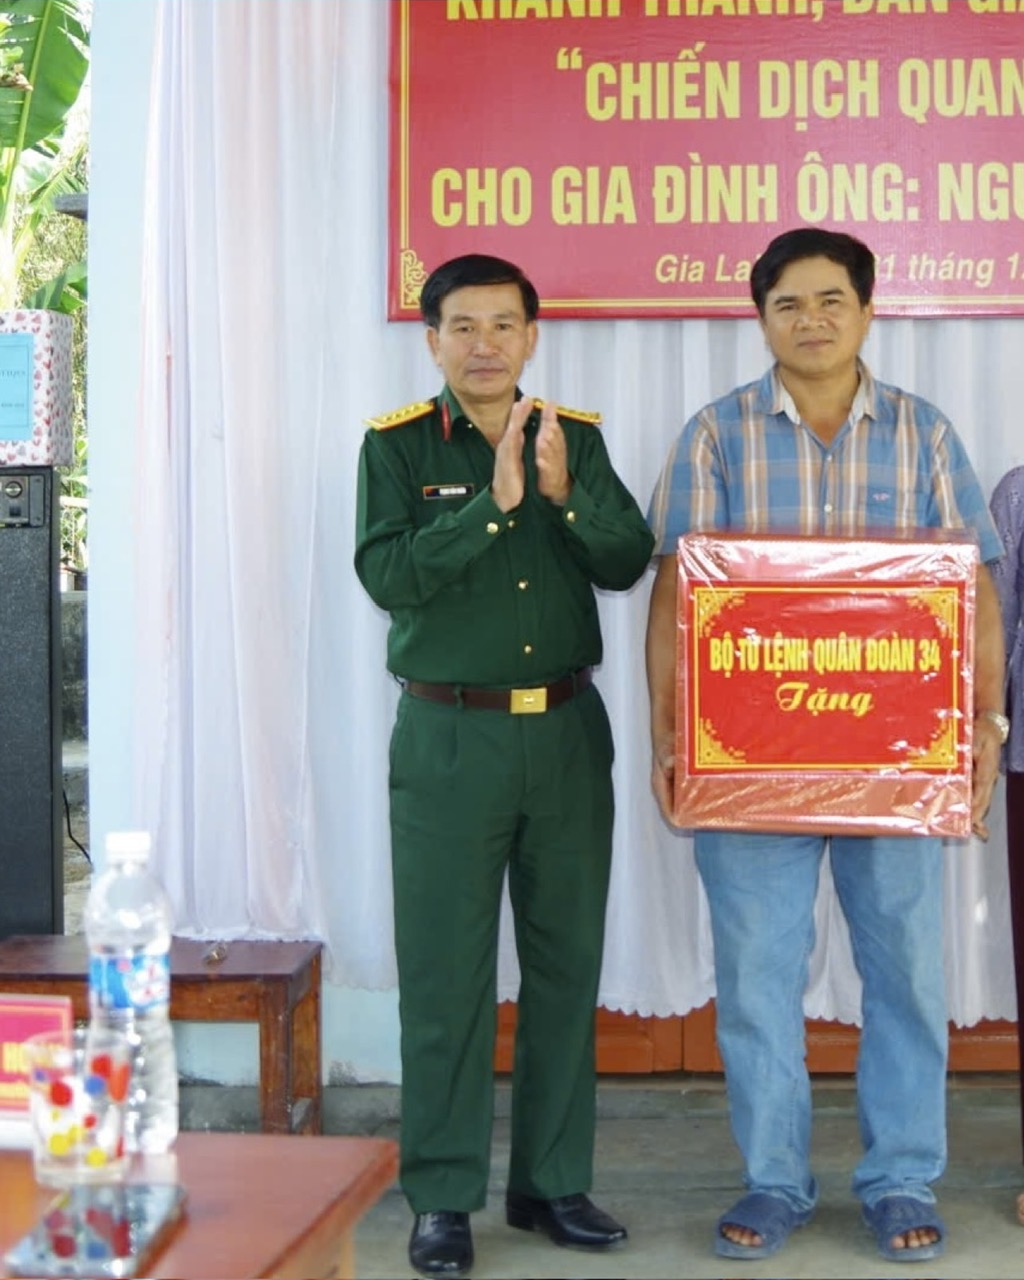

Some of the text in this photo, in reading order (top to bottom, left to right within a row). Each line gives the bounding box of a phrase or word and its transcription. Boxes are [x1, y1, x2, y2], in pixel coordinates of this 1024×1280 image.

[759, 59, 880, 132] DỊCH
[431, 166, 532, 227] CHO
[551, 165, 636, 225] GIA
[652, 152, 779, 224] ĐÌNH
[796, 151, 920, 223] ÔNG:
[655, 254, 705, 283] Gia
[715, 255, 758, 283] La
[908, 251, 994, 287] tháng
[709, 631, 734, 678] BỘ
[764, 631, 809, 678] LỆNH
[813, 631, 861, 675] QUÂN
[866, 632, 915, 672] ĐOÀN
[919, 638, 942, 672] 34
[776, 681, 874, 718] Tặng
